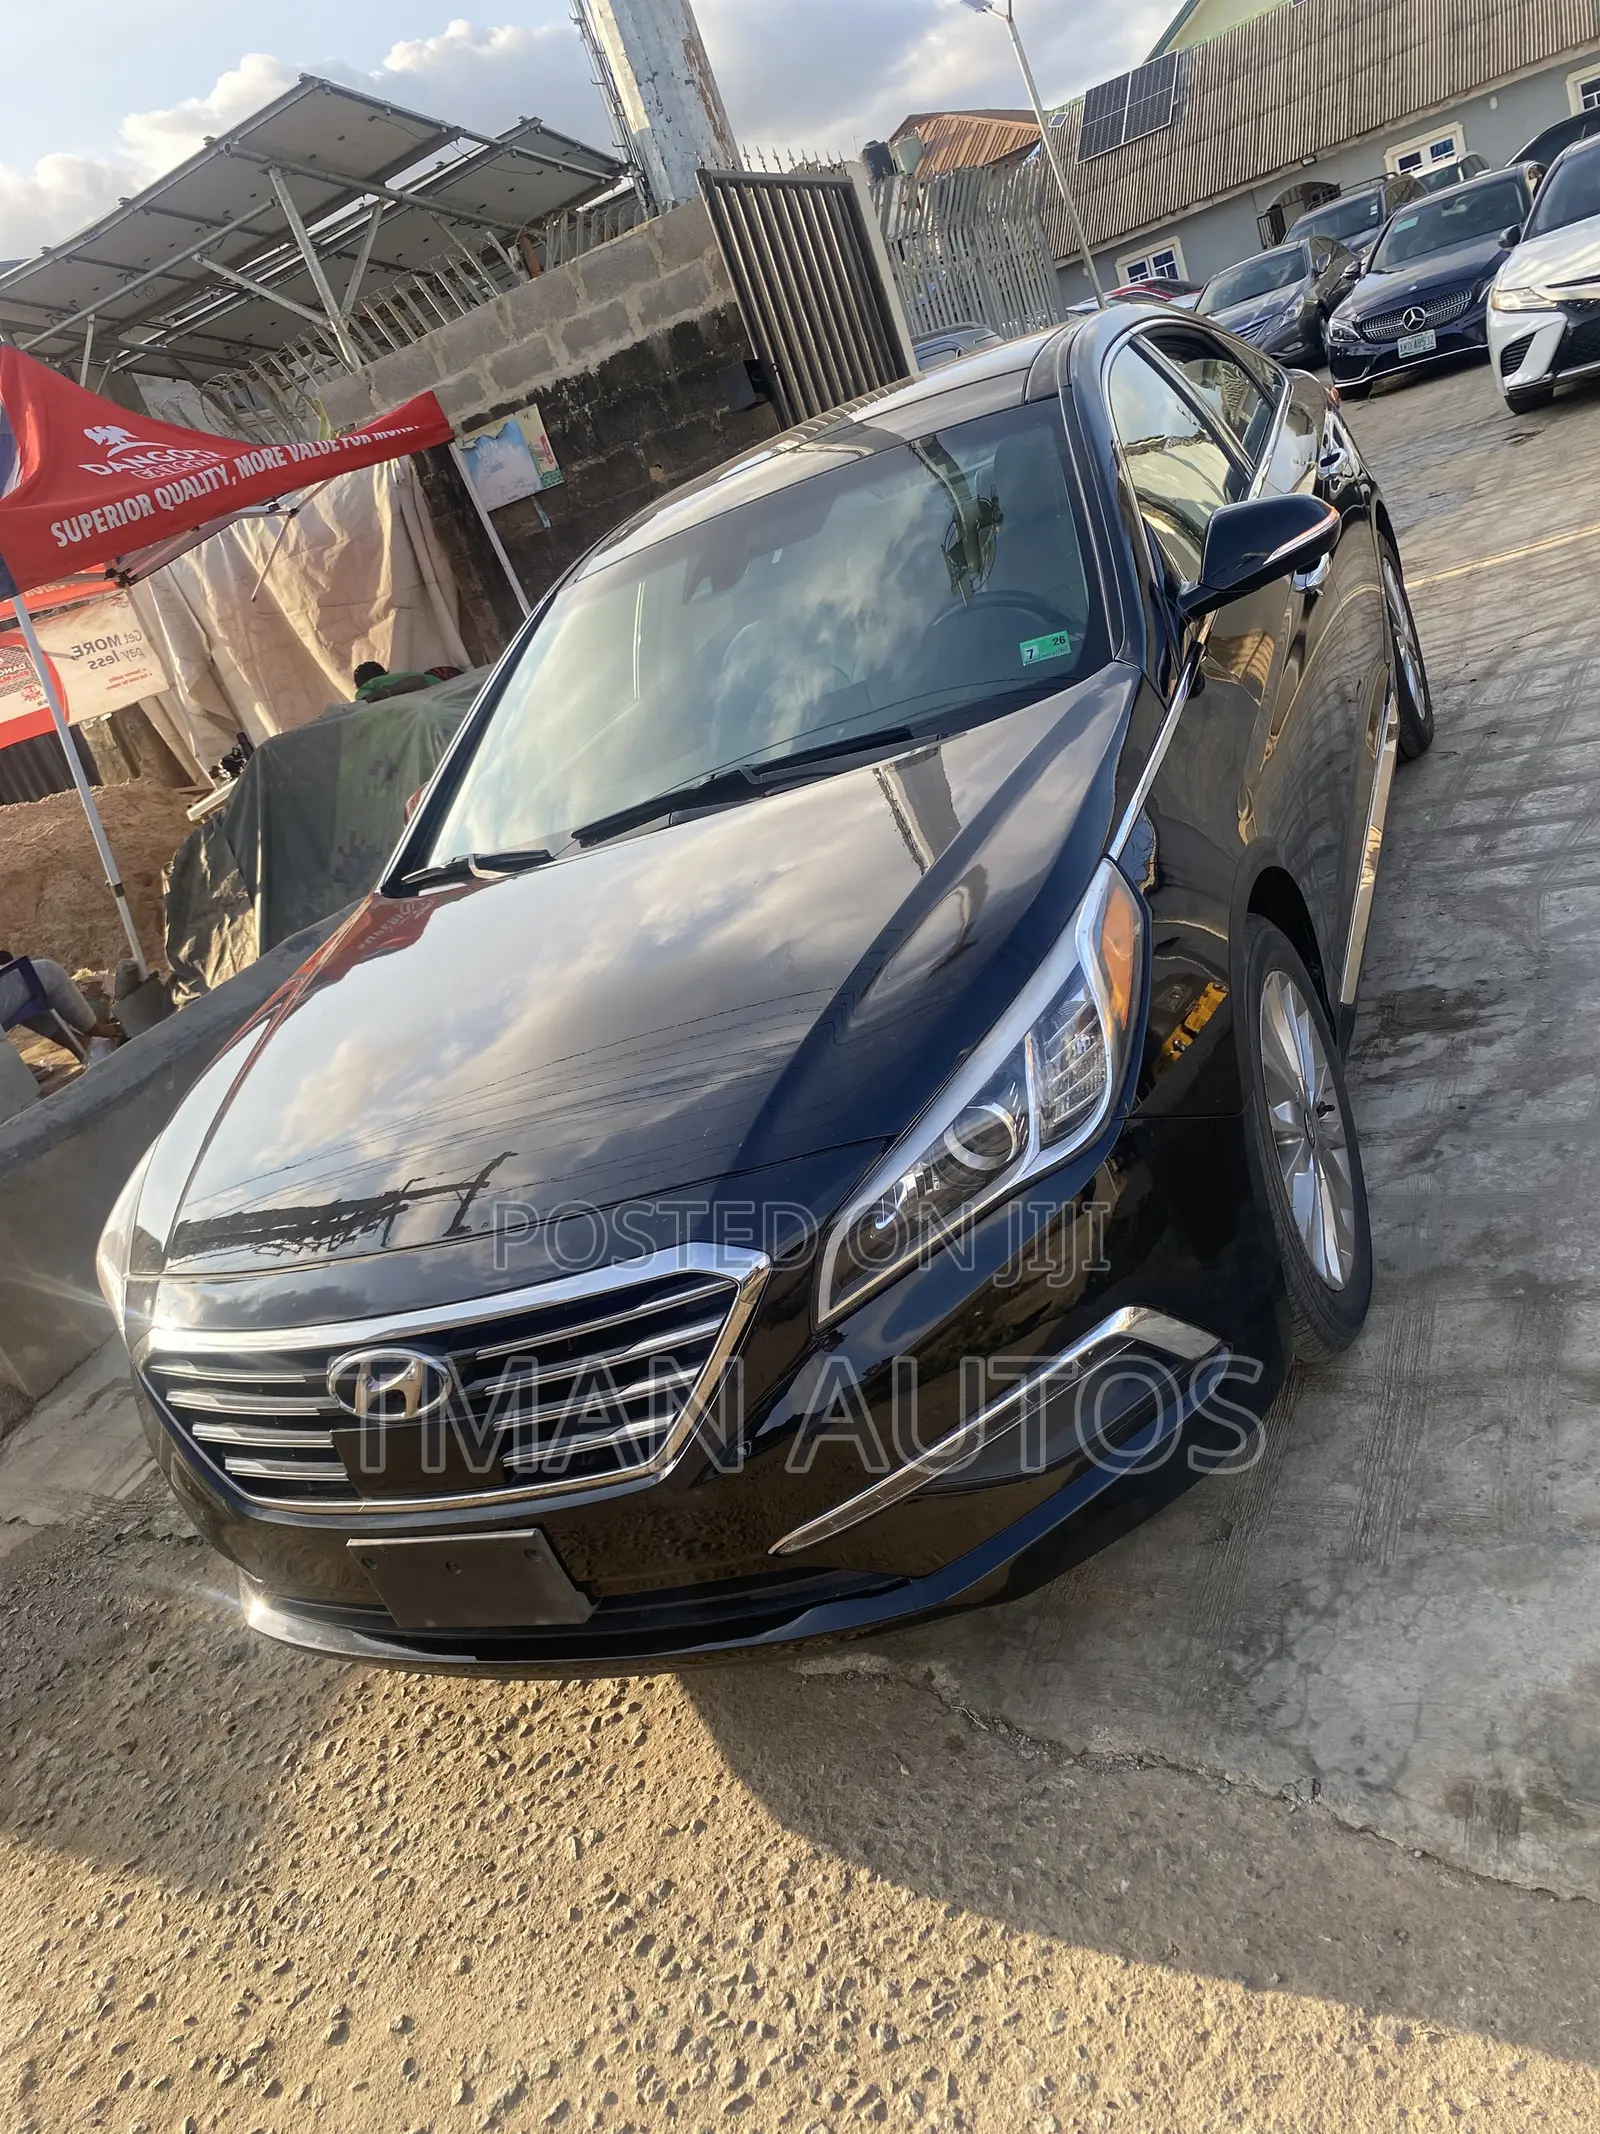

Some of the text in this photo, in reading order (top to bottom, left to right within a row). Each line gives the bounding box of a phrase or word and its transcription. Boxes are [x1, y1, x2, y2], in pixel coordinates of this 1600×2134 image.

[77, 449, 228, 475] DANGOTE
[51, 493, 155, 548] SUPERIOR
[233, 446, 287, 479] MORE
[284, 440, 340, 463] VALUE
[1052, 635, 1066, 646] 26
[1026, 648, 1034, 660] 7
